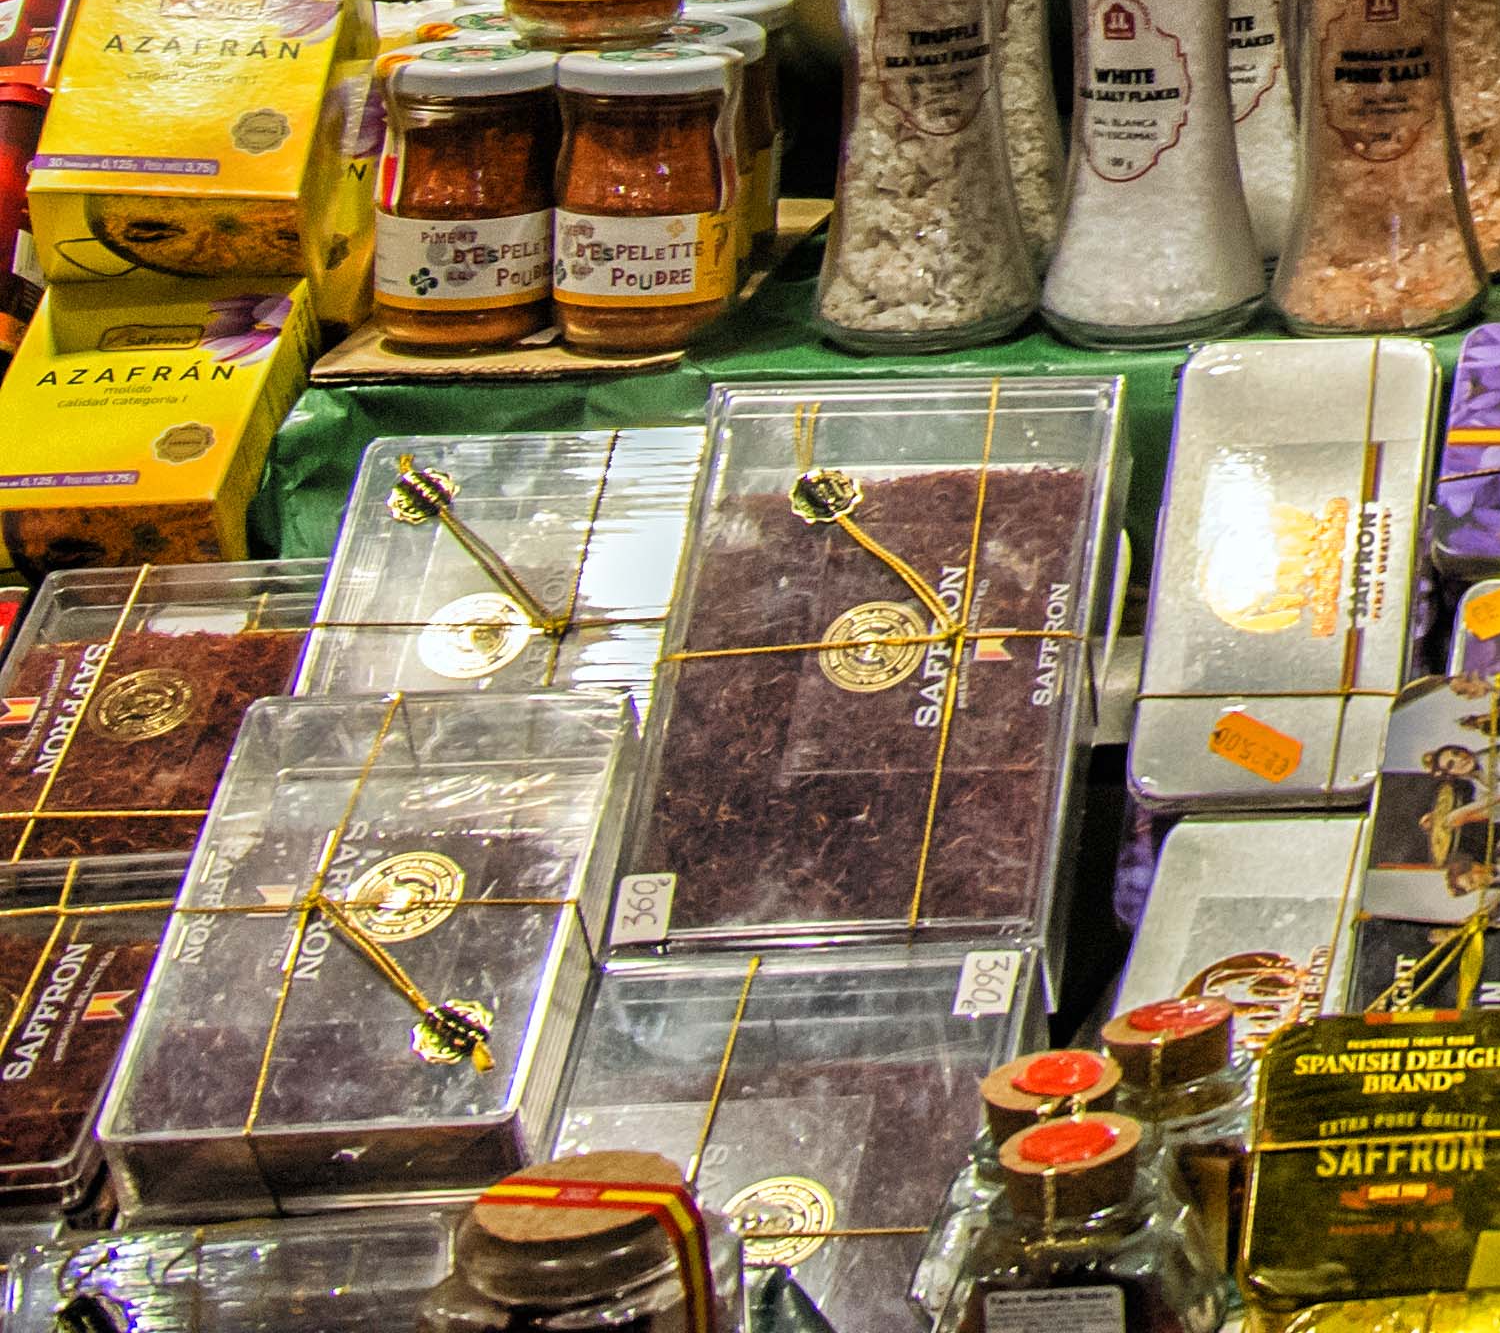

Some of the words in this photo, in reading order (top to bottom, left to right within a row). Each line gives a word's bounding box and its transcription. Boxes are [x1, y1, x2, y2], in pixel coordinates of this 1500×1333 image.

[104, 32, 302, 61] AZAFRÁN
[1094, 66, 1157, 88] WHITE
[1334, 67, 1381, 85] PINK
[1387, 61, 1432, 81] SALT
[1127, 86, 1180, 103] FLAKES
[610, 266, 693, 289] POUDRE
[36, 361, 239, 388] AZAFRÁN
[56, 394, 105, 410] calidad
[103, 383, 153, 397] molido
[914, 564, 967, 729] SAFFRON
[1032, 581, 1072, 707] SAFFRON
[34, 642, 112, 775] SAFFRON
[3, 941, 94, 1082] SAFFRON
[1293, 1049, 1404, 1076] SPANISH
[1318, 1119, 1371, 1137] EXTRA
[1374, 1115, 1419, 1131] PURE
[1422, 1110, 1488, 1131] QUALITY
